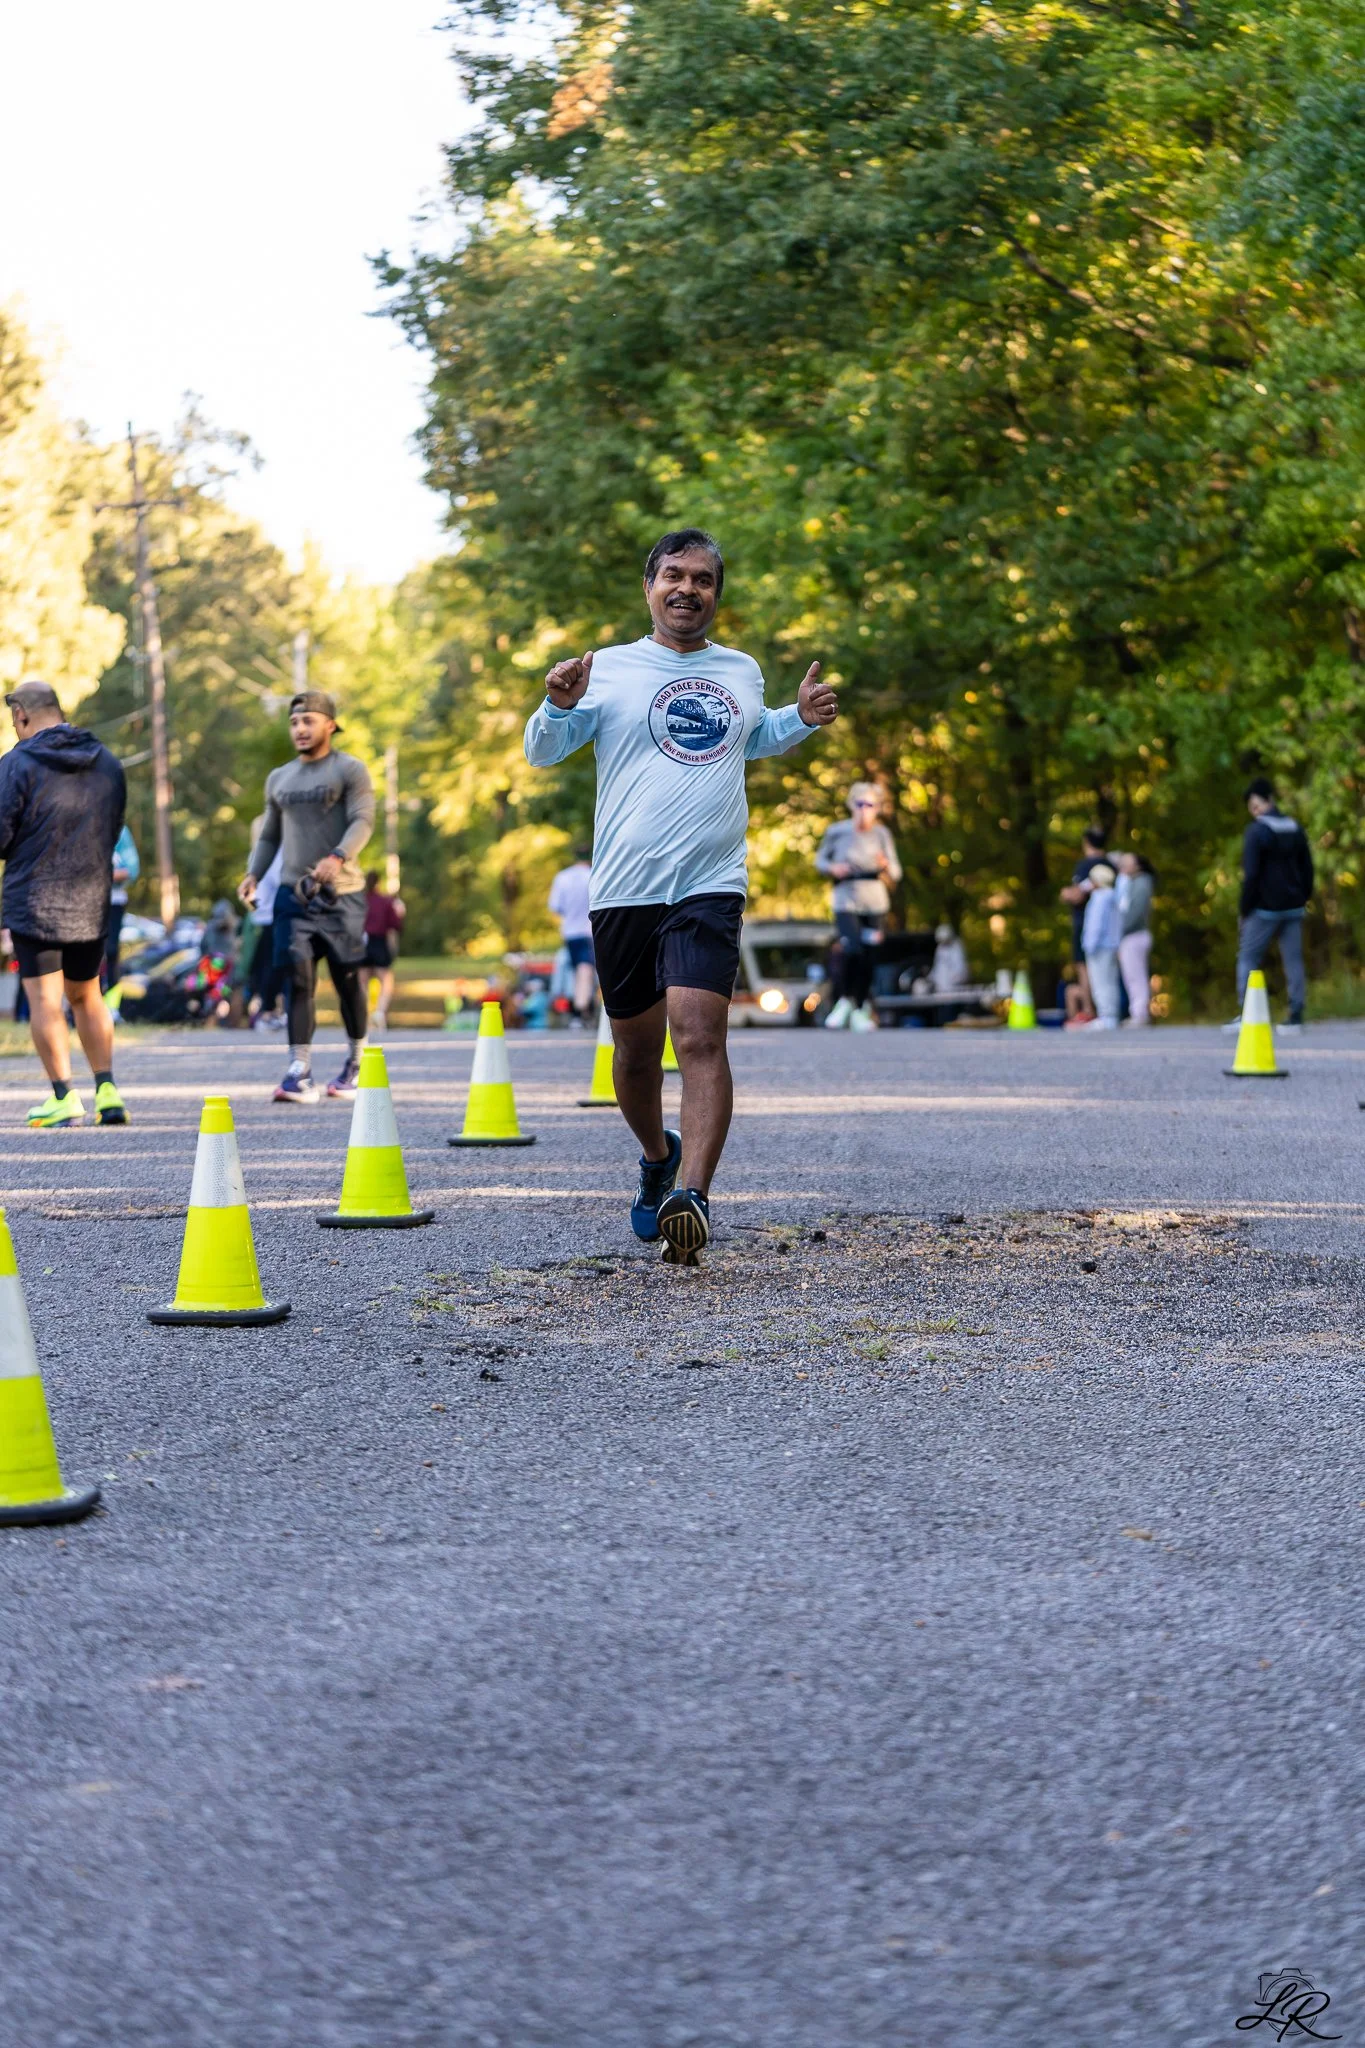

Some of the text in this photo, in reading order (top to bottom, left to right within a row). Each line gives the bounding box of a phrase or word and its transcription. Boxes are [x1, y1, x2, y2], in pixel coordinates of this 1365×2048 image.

[655, 682, 740, 715] ROAD RACE SERIES 2026
[676, 752, 700, 762] PURSER
[700, 744, 728, 762] MEMORIAL
